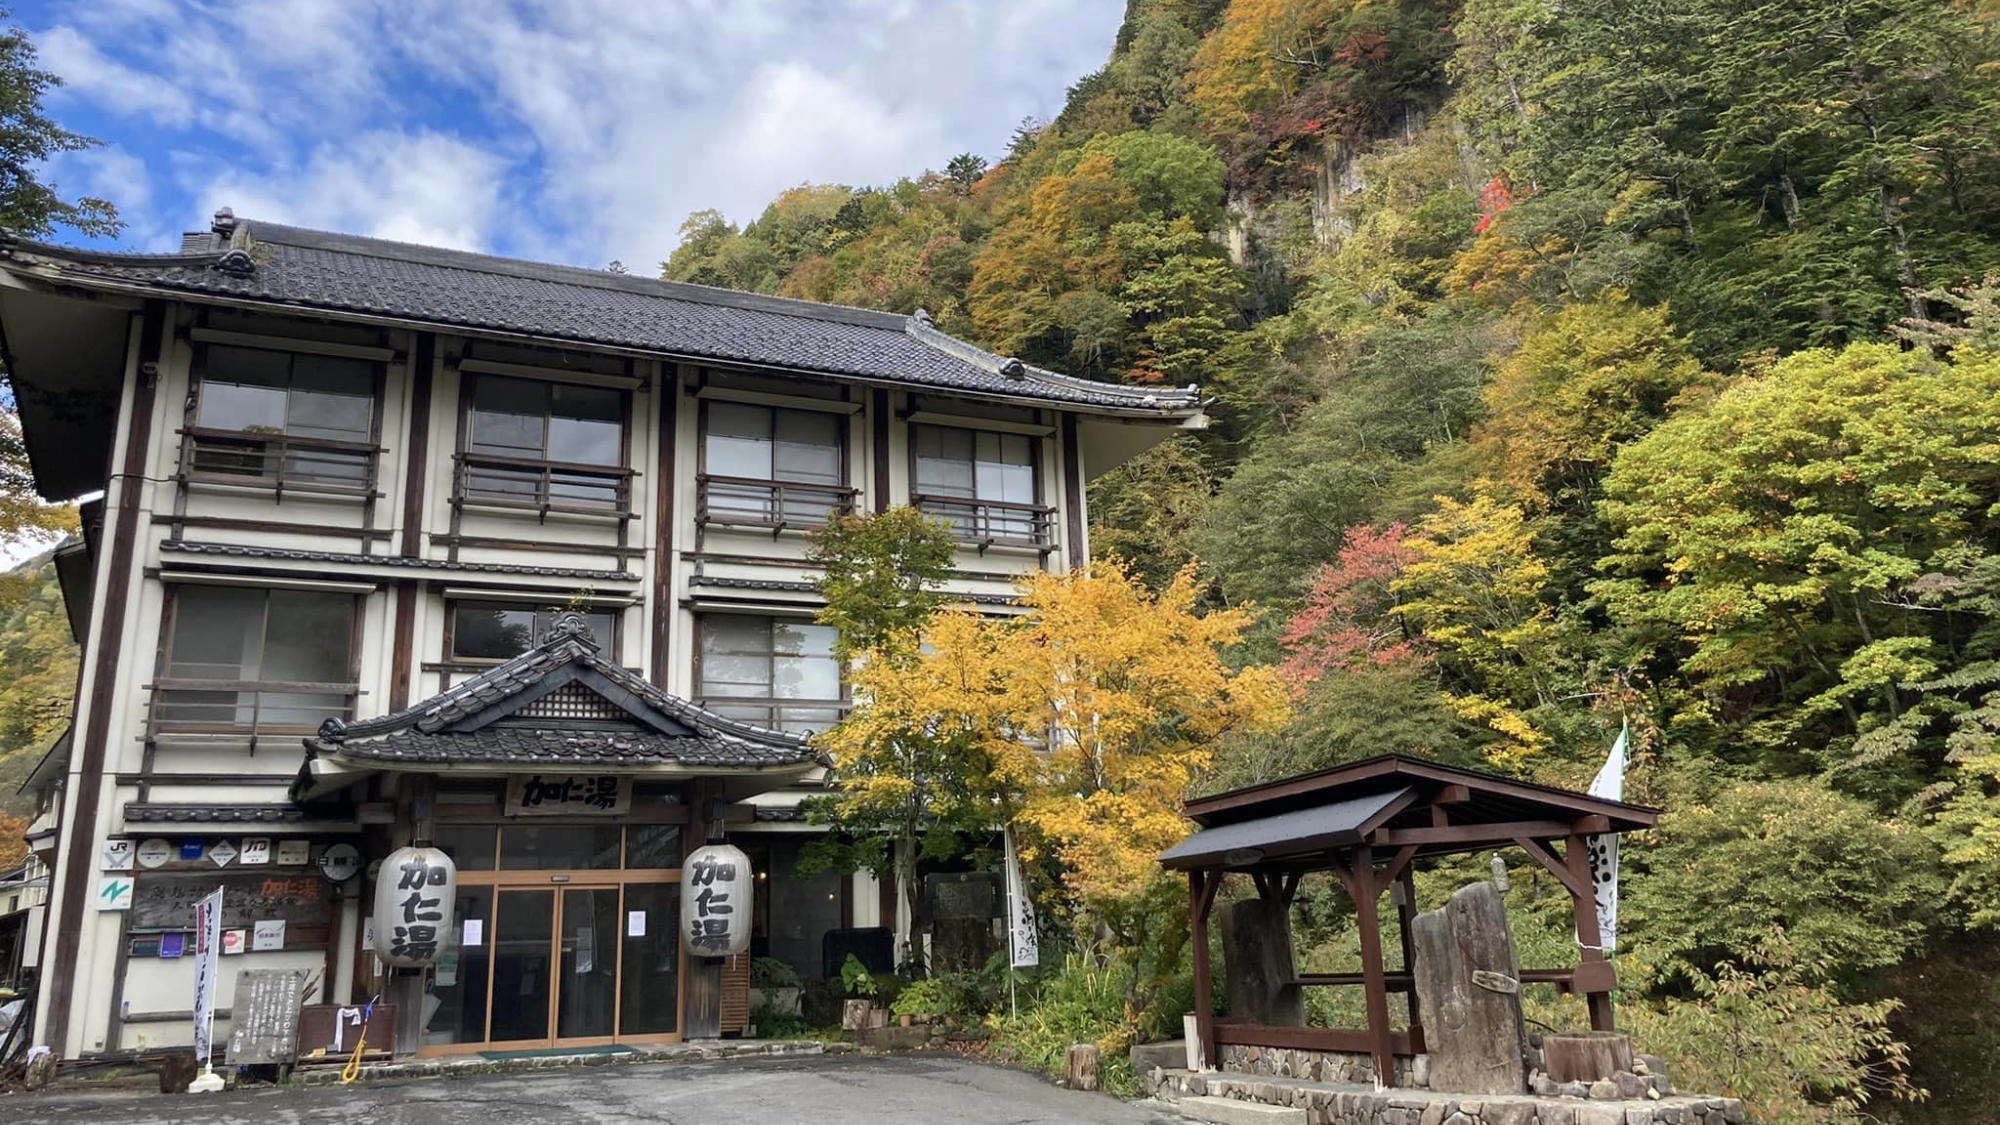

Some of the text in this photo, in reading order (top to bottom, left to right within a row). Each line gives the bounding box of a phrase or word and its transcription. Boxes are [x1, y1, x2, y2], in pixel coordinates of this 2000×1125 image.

[522, 775, 618, 809] 加仁湯
[110, 842, 128, 851] JR
[244, 839, 267, 854] JTB
[260, 877, 319, 901] 加仁湯
[691, 856, 736, 951] 加仁湯
[391, 857, 447, 961] 加仁湯
